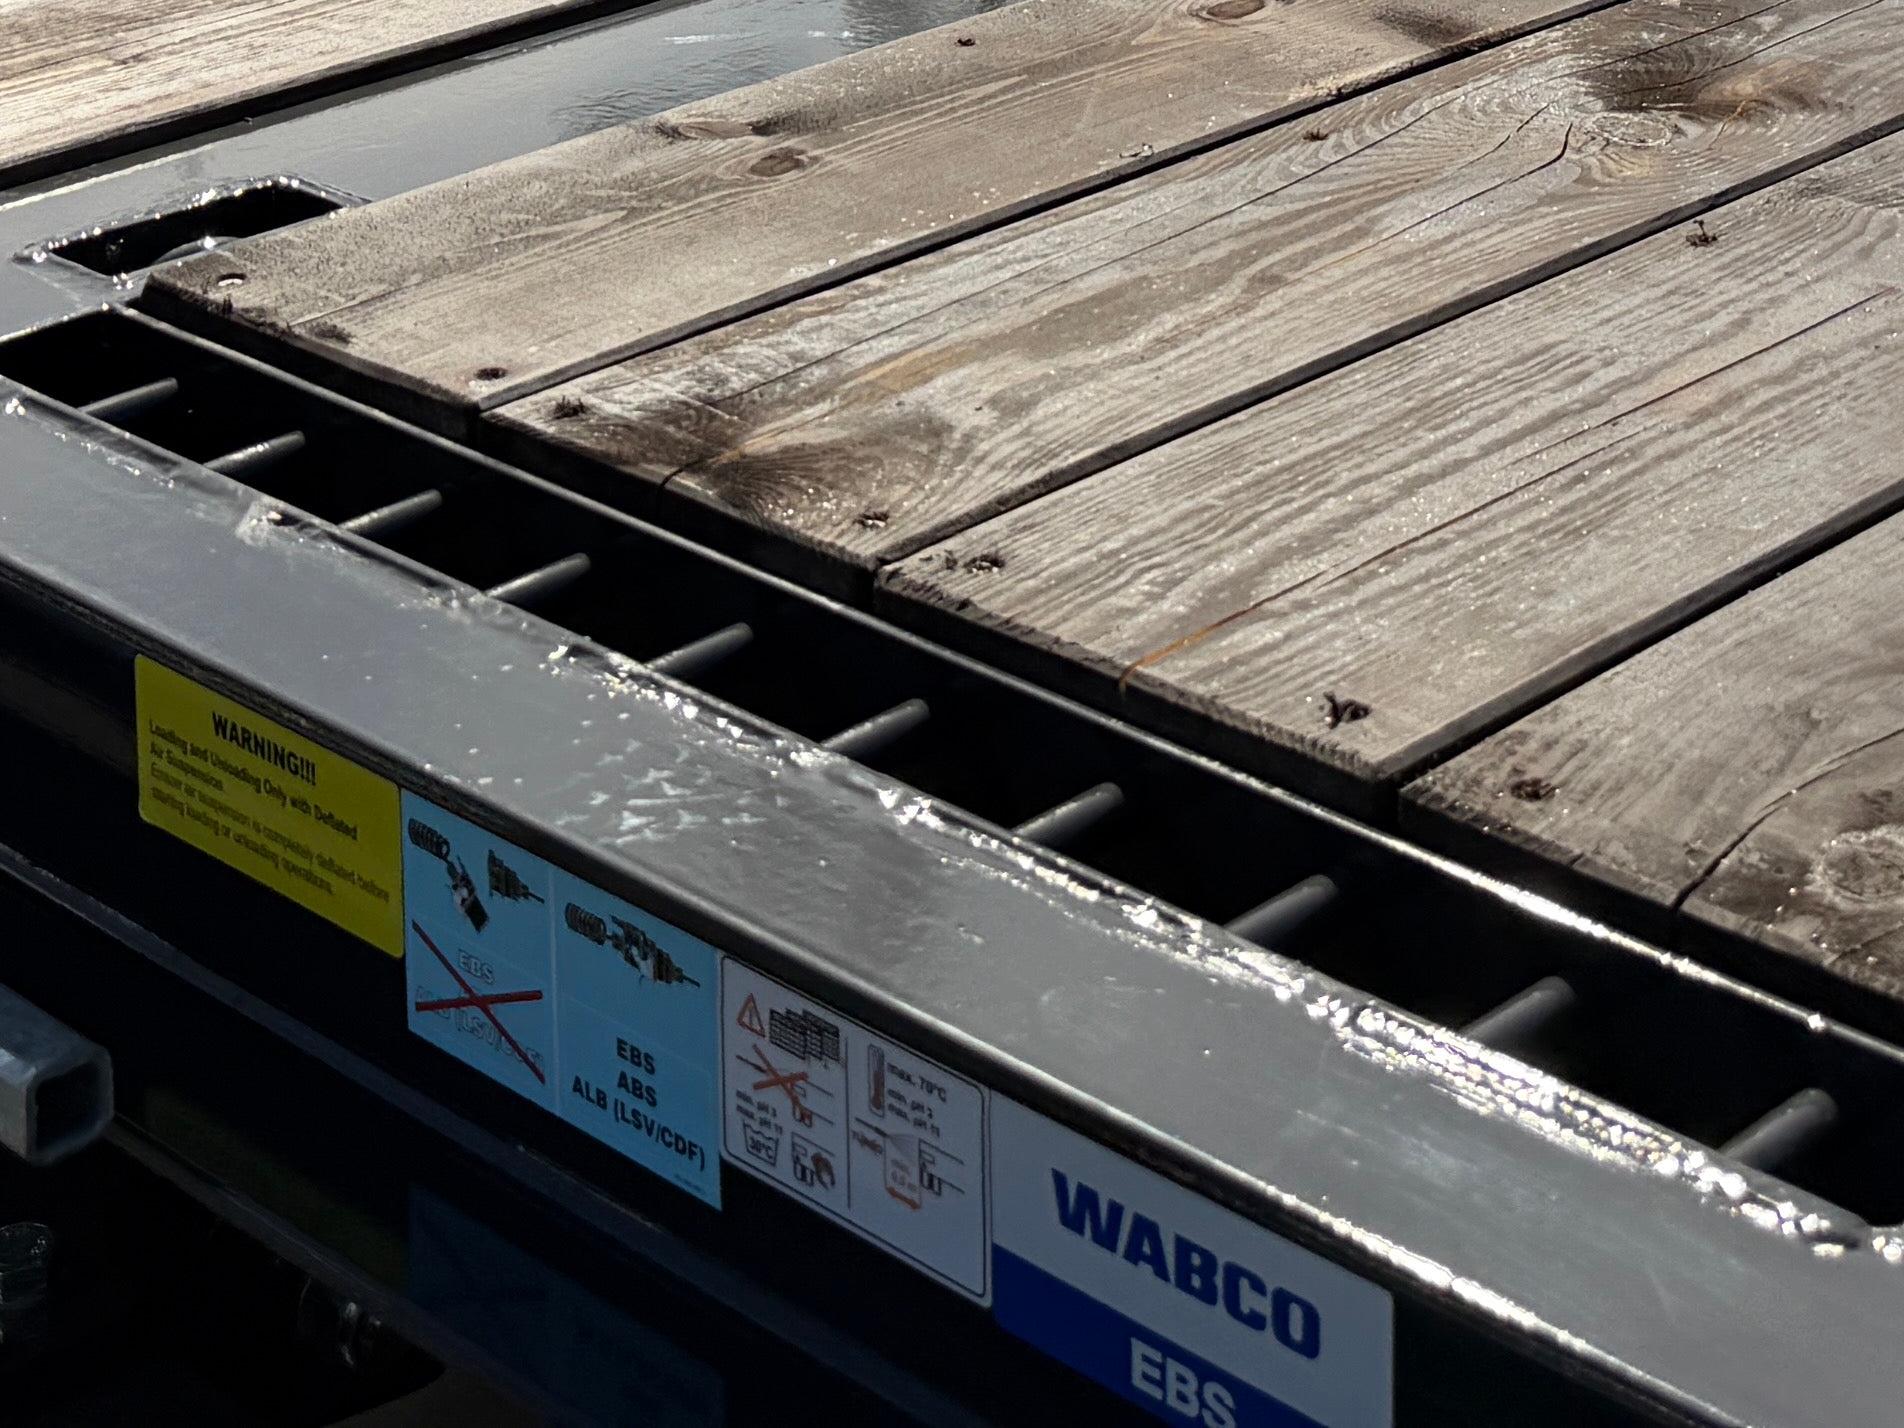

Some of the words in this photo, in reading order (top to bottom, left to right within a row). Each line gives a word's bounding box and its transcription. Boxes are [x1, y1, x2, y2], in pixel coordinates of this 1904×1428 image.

[149, 717, 188, 755] Loading
[263, 777, 287, 807] Only
[289, 797, 312, 816] with
[314, 804, 358, 841] Deflated
[212, 711, 316, 786] WARNING!!!
[458, 949, 495, 985] EBS
[616, 1037, 655, 1075] EBS
[617, 1071, 657, 1107] ABS
[920, 1076, 947, 1102] 70°C
[572, 1075, 607, 1111] ALB
[614, 1098, 705, 1172] (LSV/CDF)
[1051, 1167, 1321, 1360] WABCO
[1131, 1337, 1236, 1428] EBS
